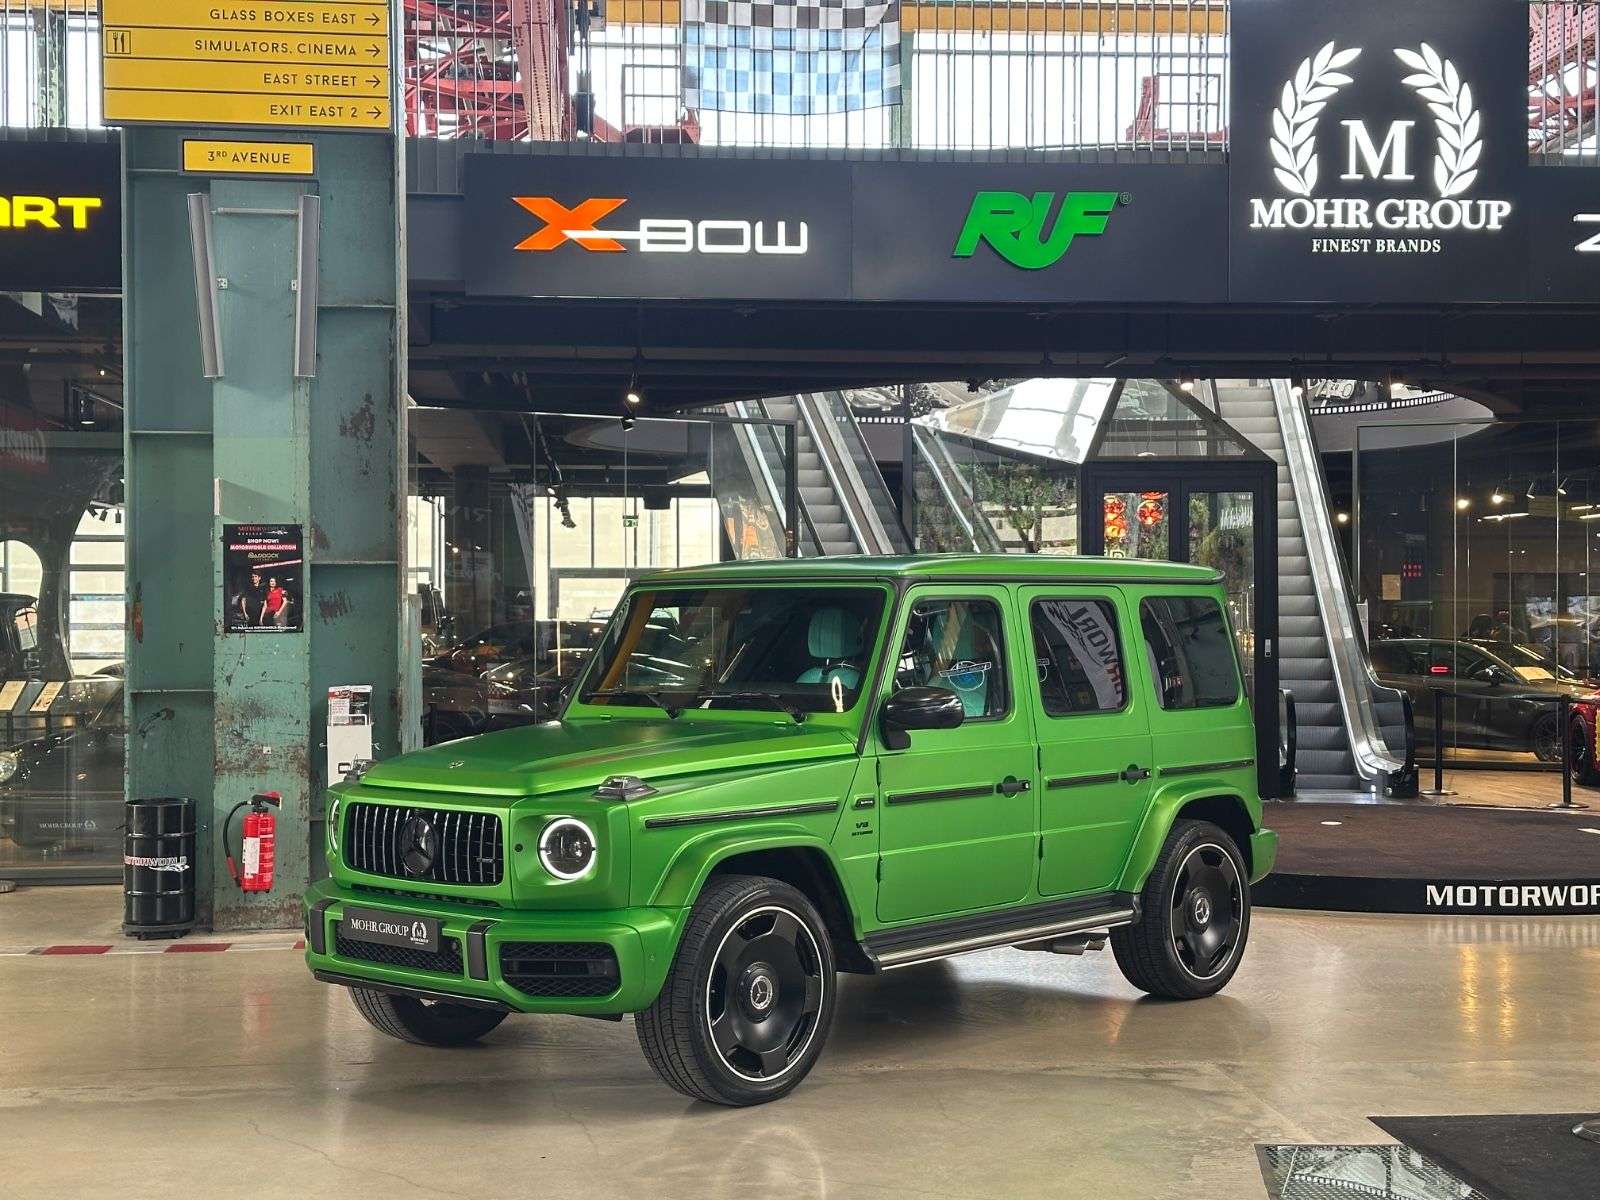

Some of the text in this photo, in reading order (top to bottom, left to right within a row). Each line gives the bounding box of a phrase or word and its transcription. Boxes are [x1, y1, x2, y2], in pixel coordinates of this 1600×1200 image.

[209, 9, 357, 25] GLASS BOXES EAST
[296, 43, 357, 56] CINEMA
[263, 73, 357, 87] EAST STREET
[270, 104, 358, 118] EXIT EAST 2
[1340, 119, 1416, 180] M
[231, 152, 291, 164] AVENUE
[1249, 197, 1512, 230] MOHR GROUP
[1311, 238, 1442, 254] FINEST BRANDS
[351, 918, 408, 935] MOHR GROUP
